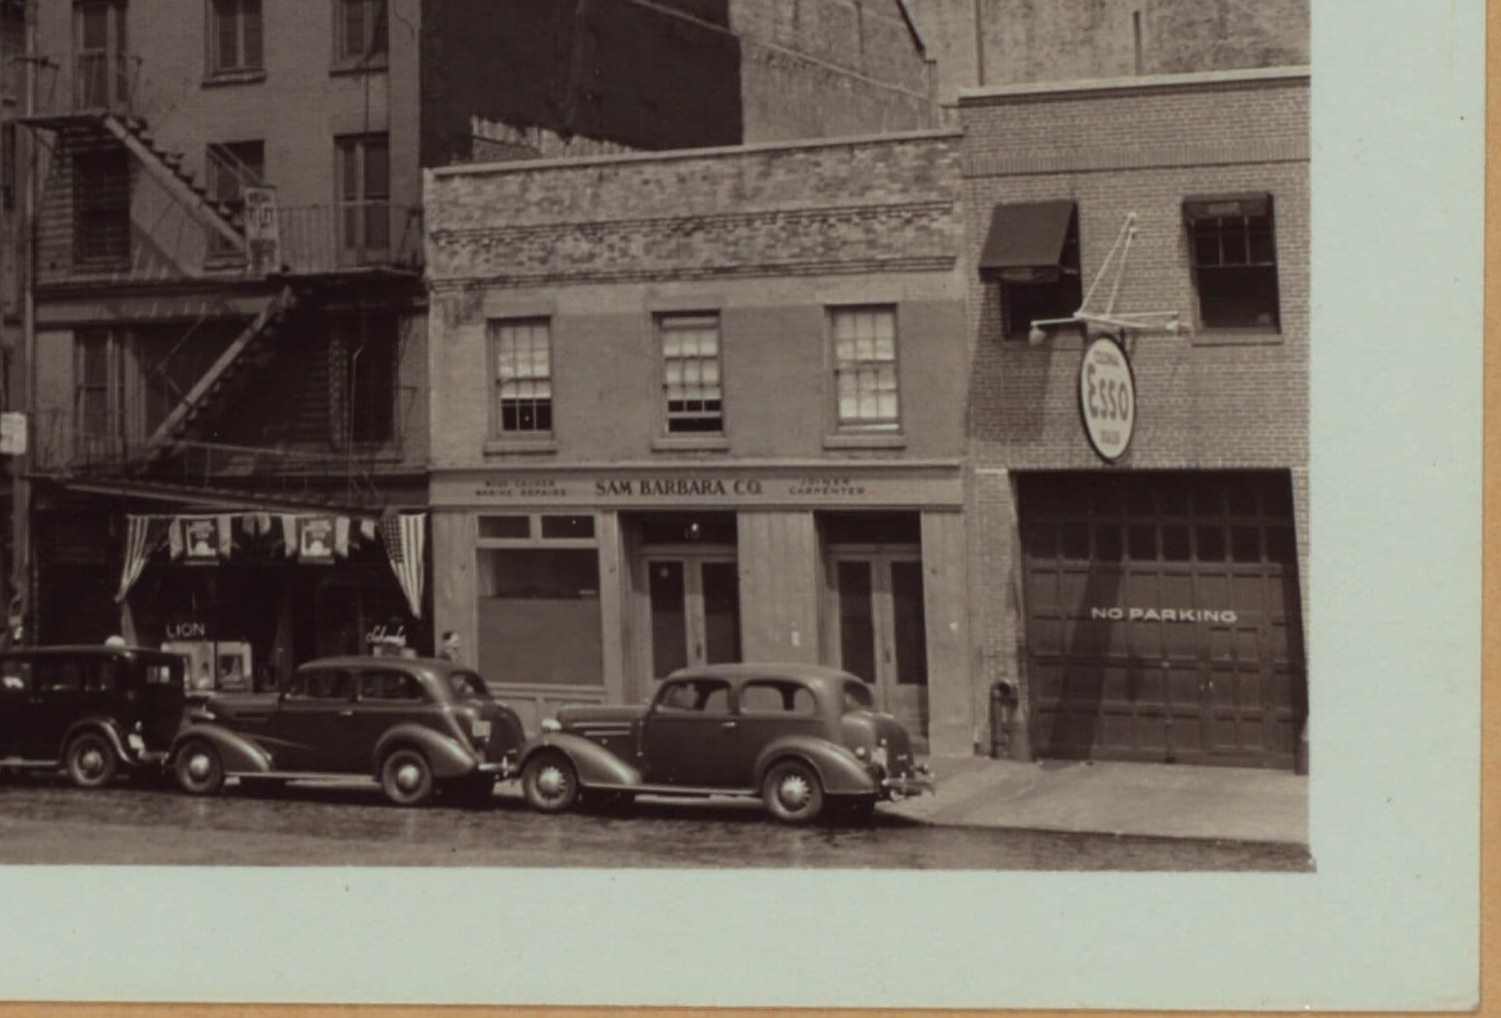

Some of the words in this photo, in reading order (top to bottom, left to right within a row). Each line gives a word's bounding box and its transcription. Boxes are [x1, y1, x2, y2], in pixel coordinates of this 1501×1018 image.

[520, 488, 566, 496] REPAIRS
[595, 479, 633, 495] SAM
[639, 479, 726, 495] BARBARA
[788, 486, 865, 495] CARPENTER
[1090, 606, 1123, 620] NO
[1128, 607, 1238, 623] PARKING
[165, 622, 206, 638] LION
